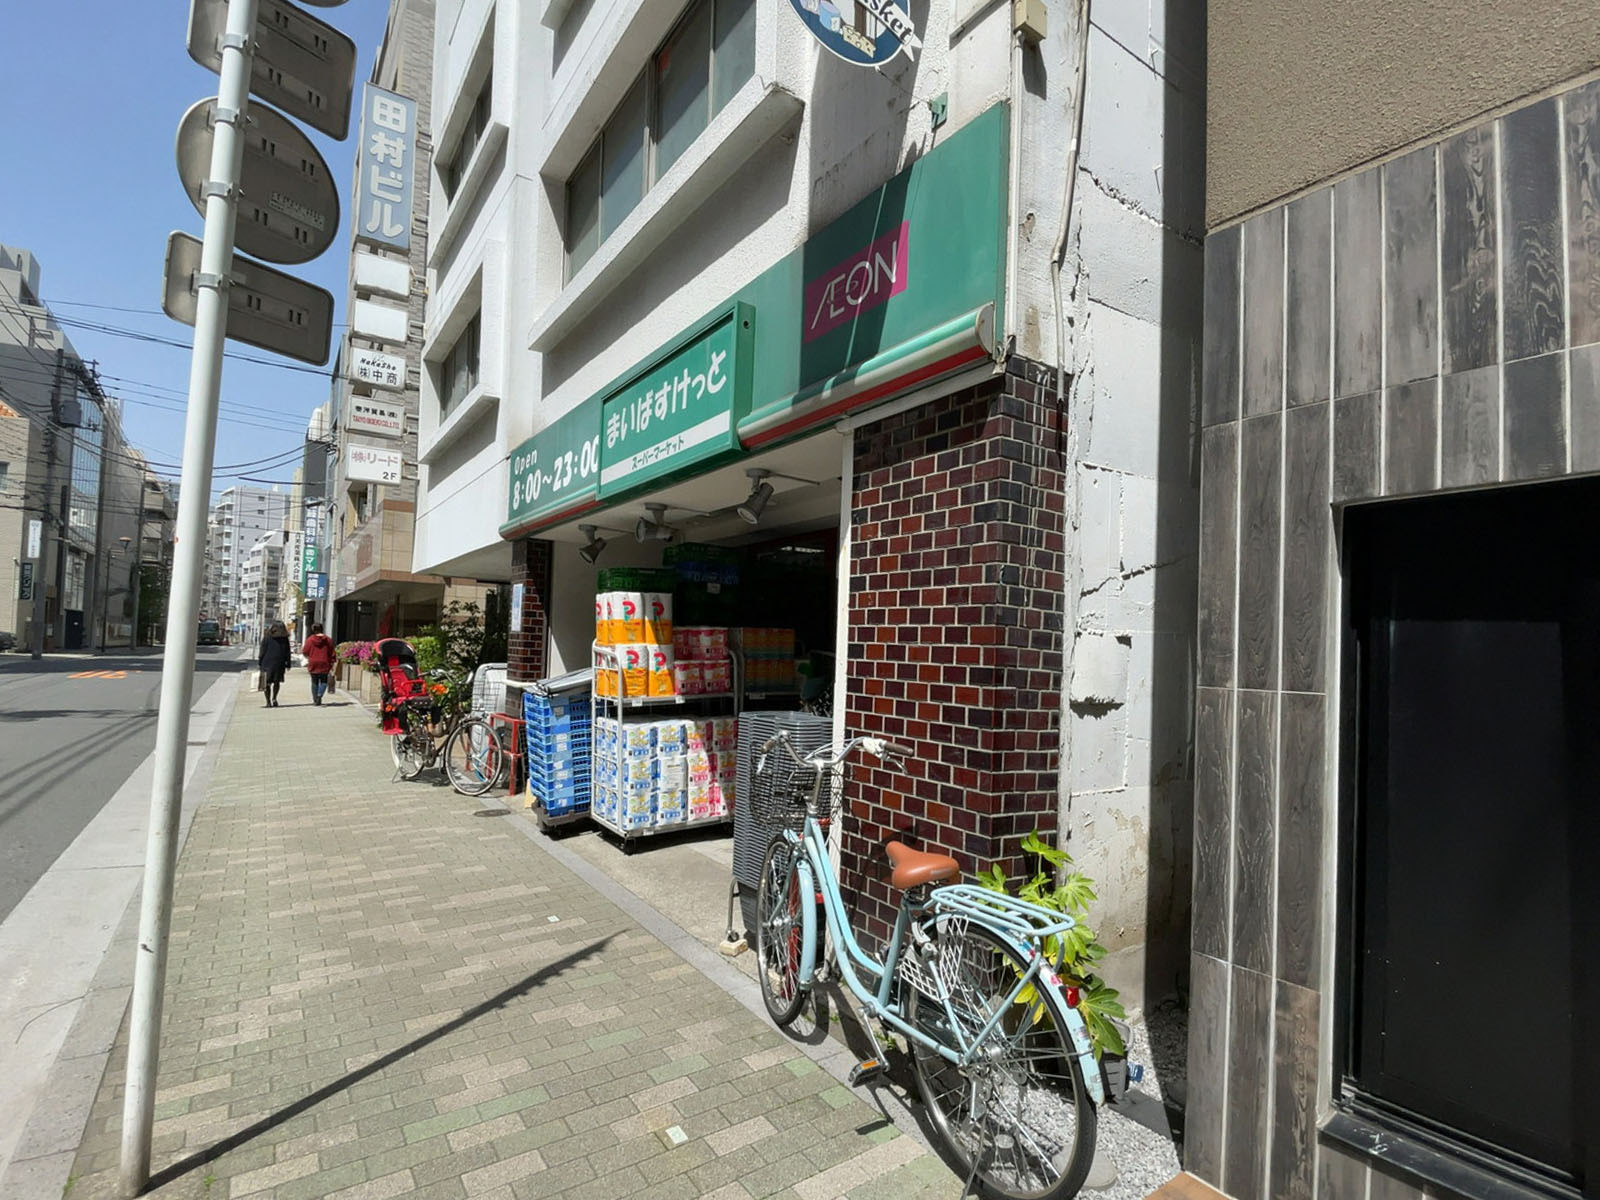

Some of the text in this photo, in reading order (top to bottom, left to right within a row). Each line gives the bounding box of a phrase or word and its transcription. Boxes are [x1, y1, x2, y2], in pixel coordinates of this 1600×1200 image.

[866, 0, 912, 42] sket
[367, 94, 406, 237] 田村ビル
[606, 350, 727, 449] まいばすけっと
[514, 449, 537, 475] Open
[631, 435, 685, 470] スーパーマーケット
[382, 471, 397, 480] 2F
